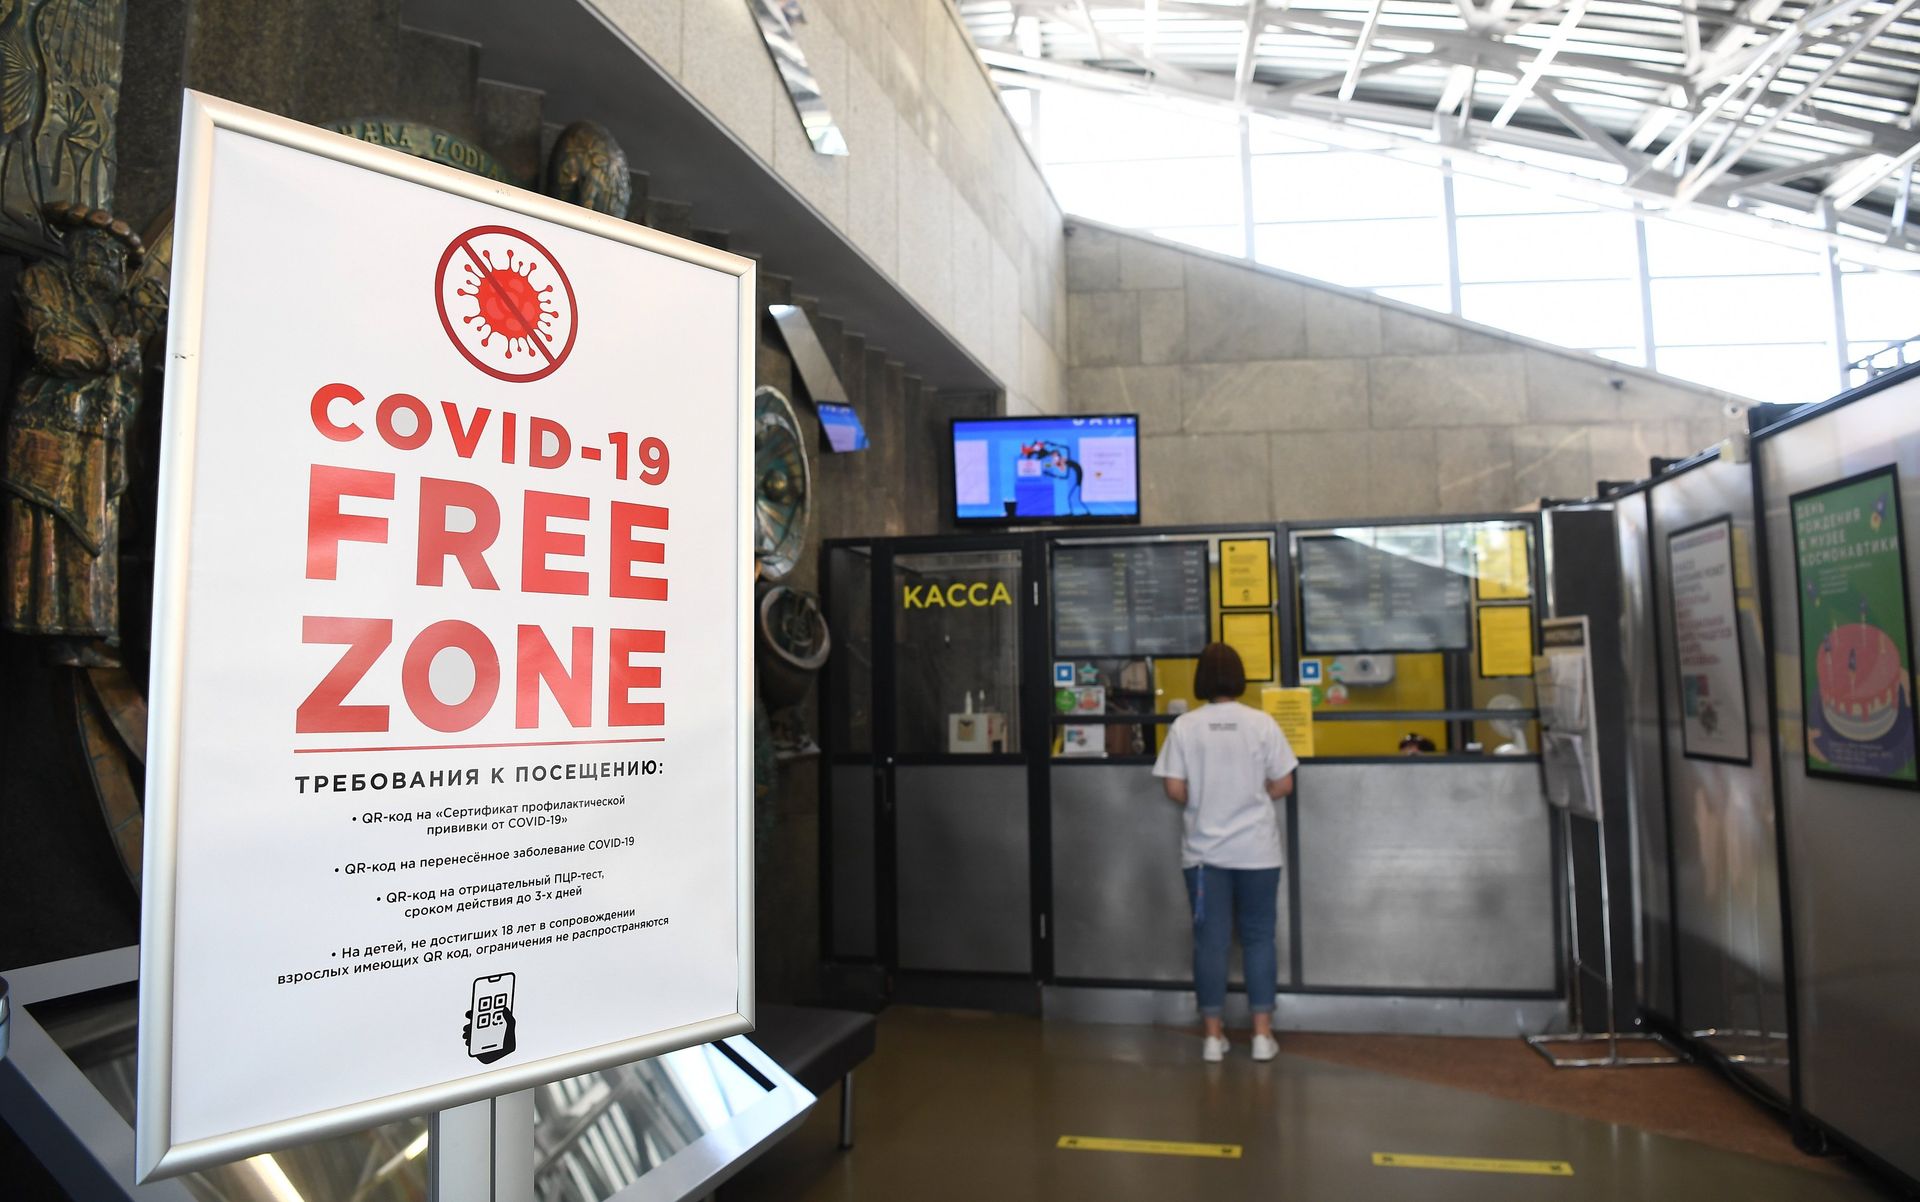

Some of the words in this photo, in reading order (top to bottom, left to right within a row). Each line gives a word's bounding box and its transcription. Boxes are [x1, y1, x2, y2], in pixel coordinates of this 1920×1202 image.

[310, 383, 670, 486] COVID-19
[305, 463, 670, 602] FREE
[902, 581, 1013, 609] КАССА
[295, 615, 666, 734] ZONE
[294, 768, 479, 794] ТРЕБОВАНИЯ
[491, 767, 504, 784] К
[516, 760, 663, 783] ПОСЕЩЕНИЮ:
[362, 812, 412, 824] QR-код
[416, 811, 431, 820] на
[435, 805, 518, 819] «Сертификат
[522, 795, 625, 814] профилактической
[427, 823, 487, 837] прививки
[491, 821, 505, 830] от
[508, 814, 568, 828] COVID-19»
[345, 862, 396, 875] QR-код
[400, 860, 416, 870] на
[420, 851, 510, 868] перенесённое
[513, 843, 585, 859] заболевание
[588, 836, 635, 850] COVID-19
[386, 890, 436, 903] QR-код
[440, 888, 455, 897] на
[458, 874, 551, 896] отрицательный
[554, 870, 604, 884] ПЦР-тест,
[404, 904, 453, 919] сроком
[456, 896, 513, 913] действия
[516, 894, 531, 905] до
[535, 890, 552, 901] 3-х
[555, 885, 582, 900] дней
[277, 965, 350, 985] взрослых
[354, 956, 419, 974] имеющих
[423, 950, 443, 963] QR
[447, 948, 472, 959] код,
[476, 936, 552, 955] ограничения
[556, 933, 569, 942] не
[572, 917, 669, 942] распространяются
[342, 947, 360, 959] На
[364, 939, 407, 957] детей,
[411, 939, 427, 949] не
[430, 929, 498, 948] достигших
[502, 924, 513, 936] 18
[516, 923, 536, 934] лет
[540, 922, 546, 930] в
[549, 909, 635, 929] сопровождении
